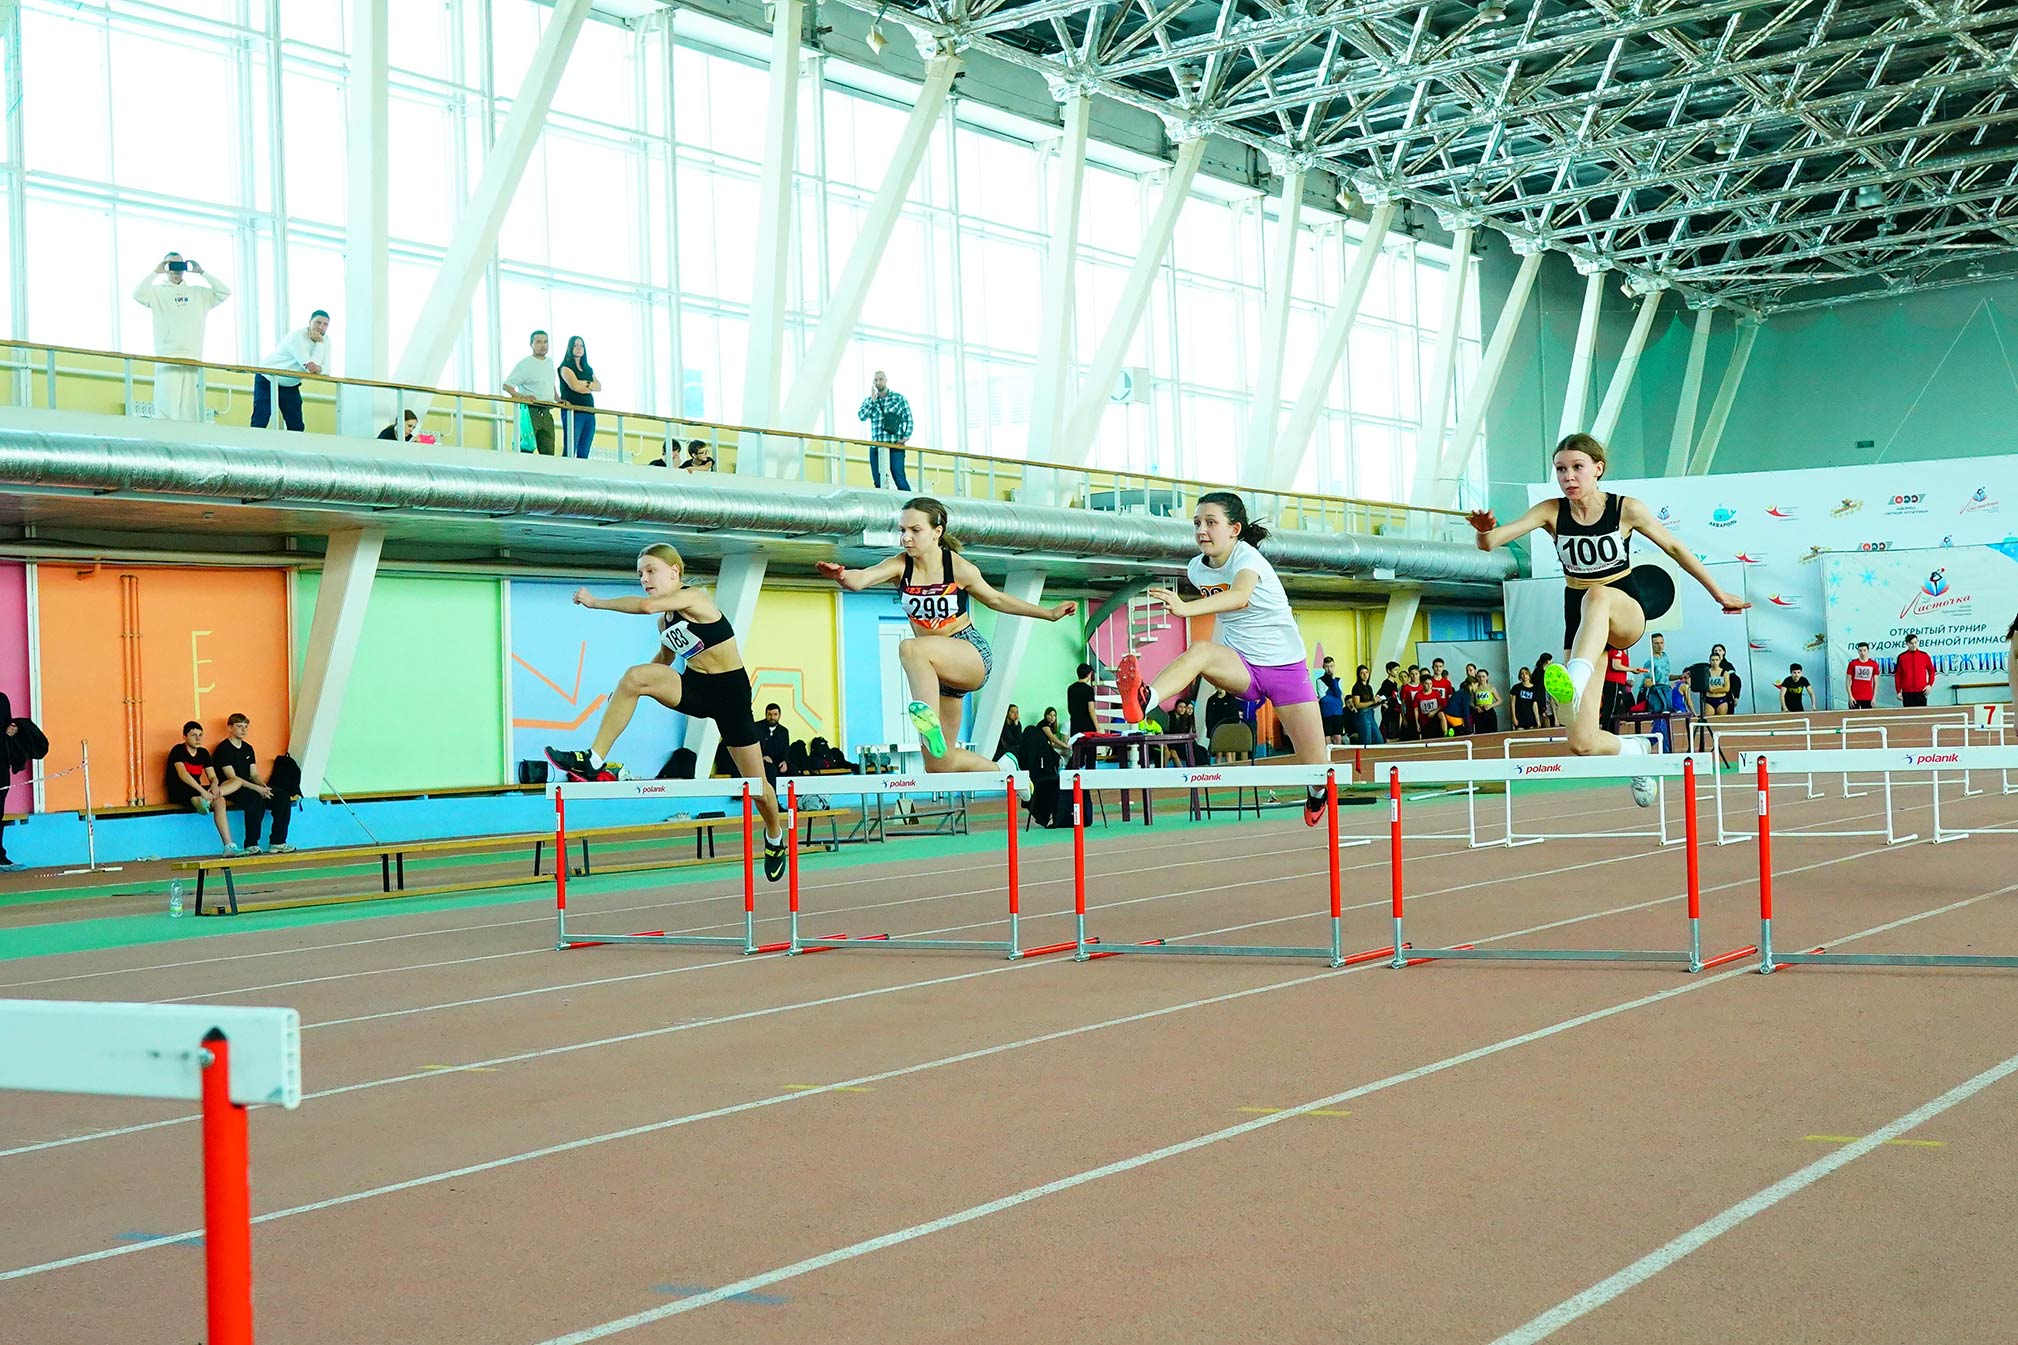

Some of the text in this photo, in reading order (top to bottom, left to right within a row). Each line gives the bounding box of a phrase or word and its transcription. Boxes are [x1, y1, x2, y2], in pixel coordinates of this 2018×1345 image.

[1563, 535, 1618, 566] 100
[909, 596, 949, 619] 299
[1900, 591, 1971, 619] Ласточка
[666, 627, 689, 650] 183
[1889, 623, 1987, 637] ОТКРЫТЫЙ ТУРНИР
[1984, 705, 1996, 725] 7
[1526, 763, 1561, 775] polanik
[1917, 753, 1959, 765] polanik
[1191, 773, 1222, 783] polanik
